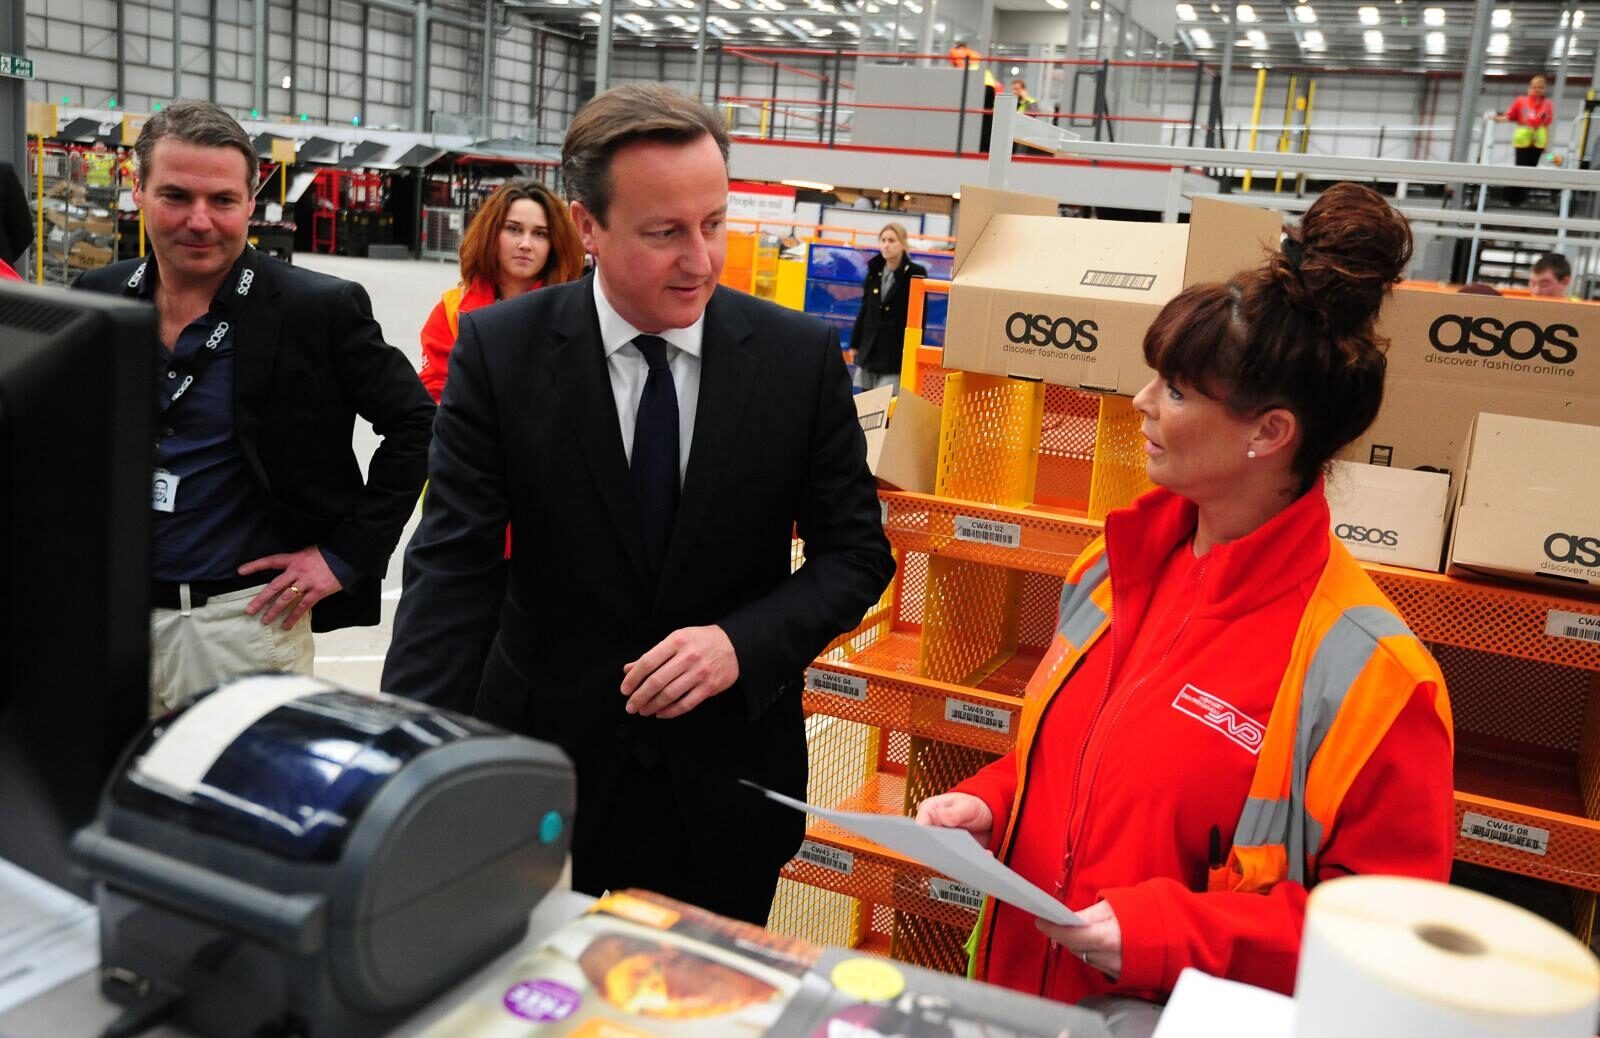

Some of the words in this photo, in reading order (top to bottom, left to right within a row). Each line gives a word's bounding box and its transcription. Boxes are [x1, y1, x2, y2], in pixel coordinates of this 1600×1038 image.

[15, 58, 31, 69] Fire
[15, 68, 30, 77] exit
[237, 268, 254, 295] asos
[206, 321, 228, 349] asos
[1005, 312, 1099, 353] asos
[1429, 314, 1579, 364] asos
[1003, 344, 1037, 356] discover
[1038, 348, 1069, 360] fashion
[1070, 353, 1097, 363] online
[1425, 352, 1479, 368] discover
[1482, 358, 1531, 373] fashion
[1533, 363, 1576, 377] online
[971, 520, 993, 531] CW45
[994, 524, 1004, 534] 02
[1335, 523, 1398, 546] asos
[1540, 560, 1584, 575] discover
[822, 672, 842, 682] CW45
[962, 703, 983, 714] CW45
[985, 708, 995, 718] 05
[1487, 820, 1514, 832] CW45
[1516, 827, 1528, 836] 08
[811, 845, 831, 857] CW45
